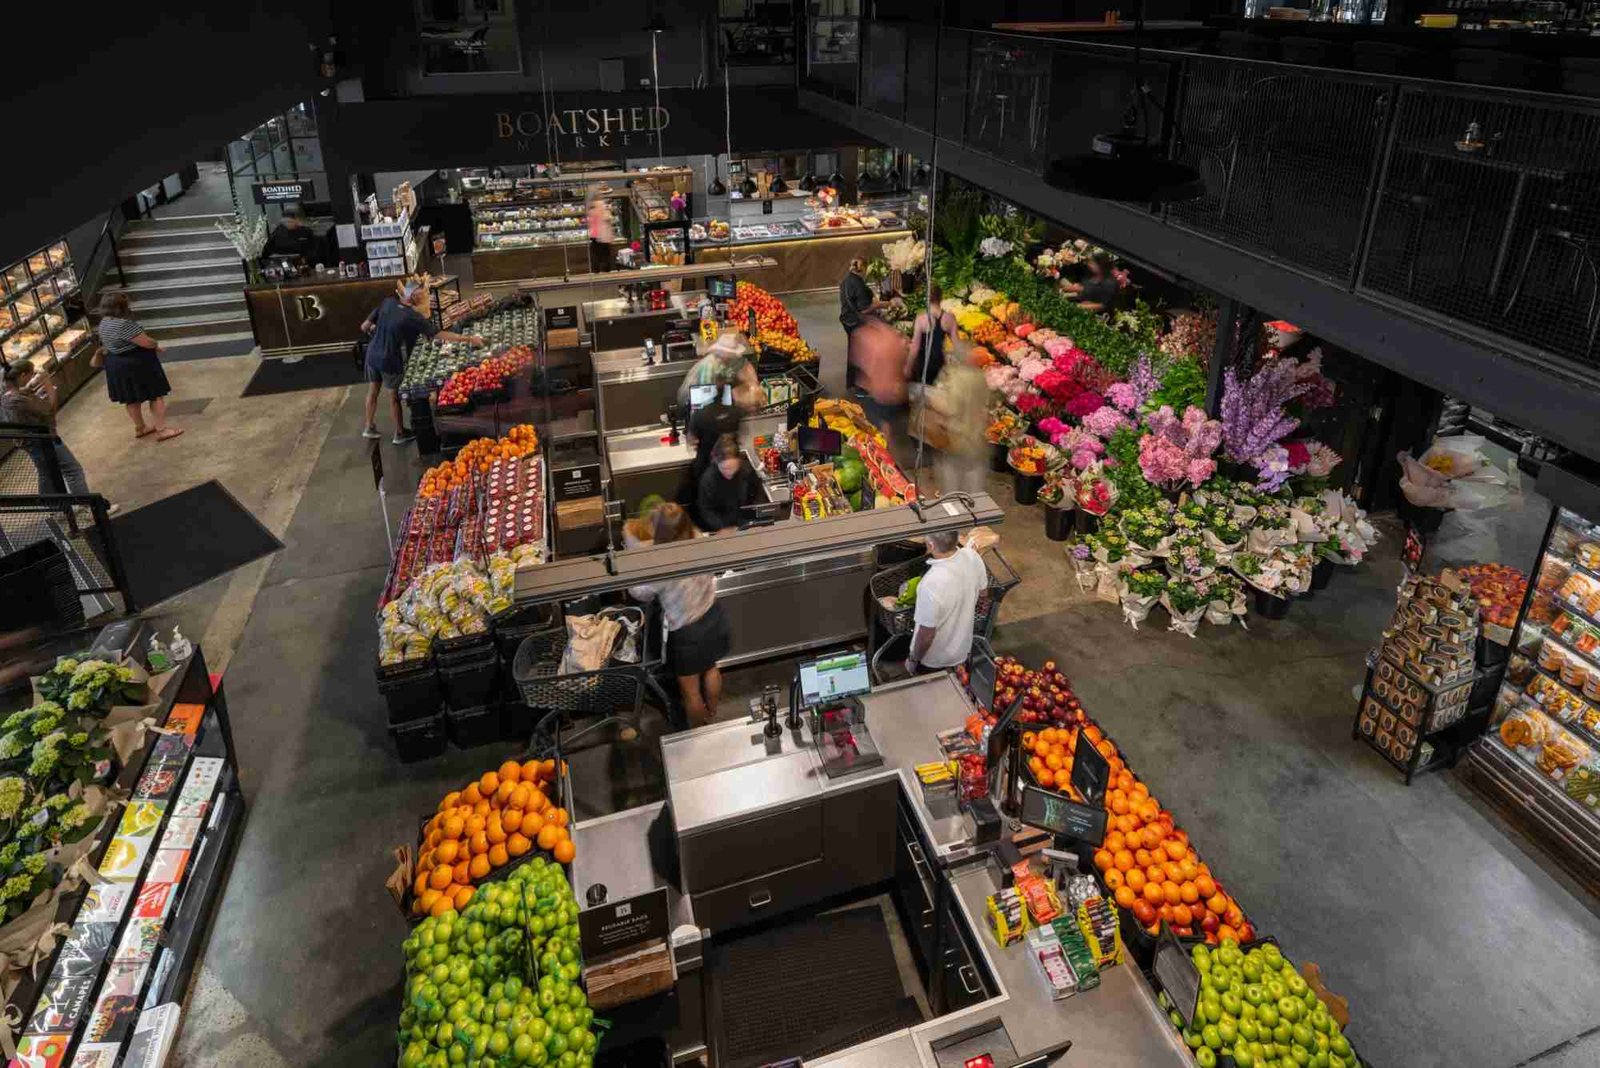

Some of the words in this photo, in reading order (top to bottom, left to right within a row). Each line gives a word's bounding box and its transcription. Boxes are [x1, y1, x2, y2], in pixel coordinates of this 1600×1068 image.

[495, 106, 671, 138] BOATSHED
[517, 132, 657, 152] MRKET
[296, 296, 321, 320] B
